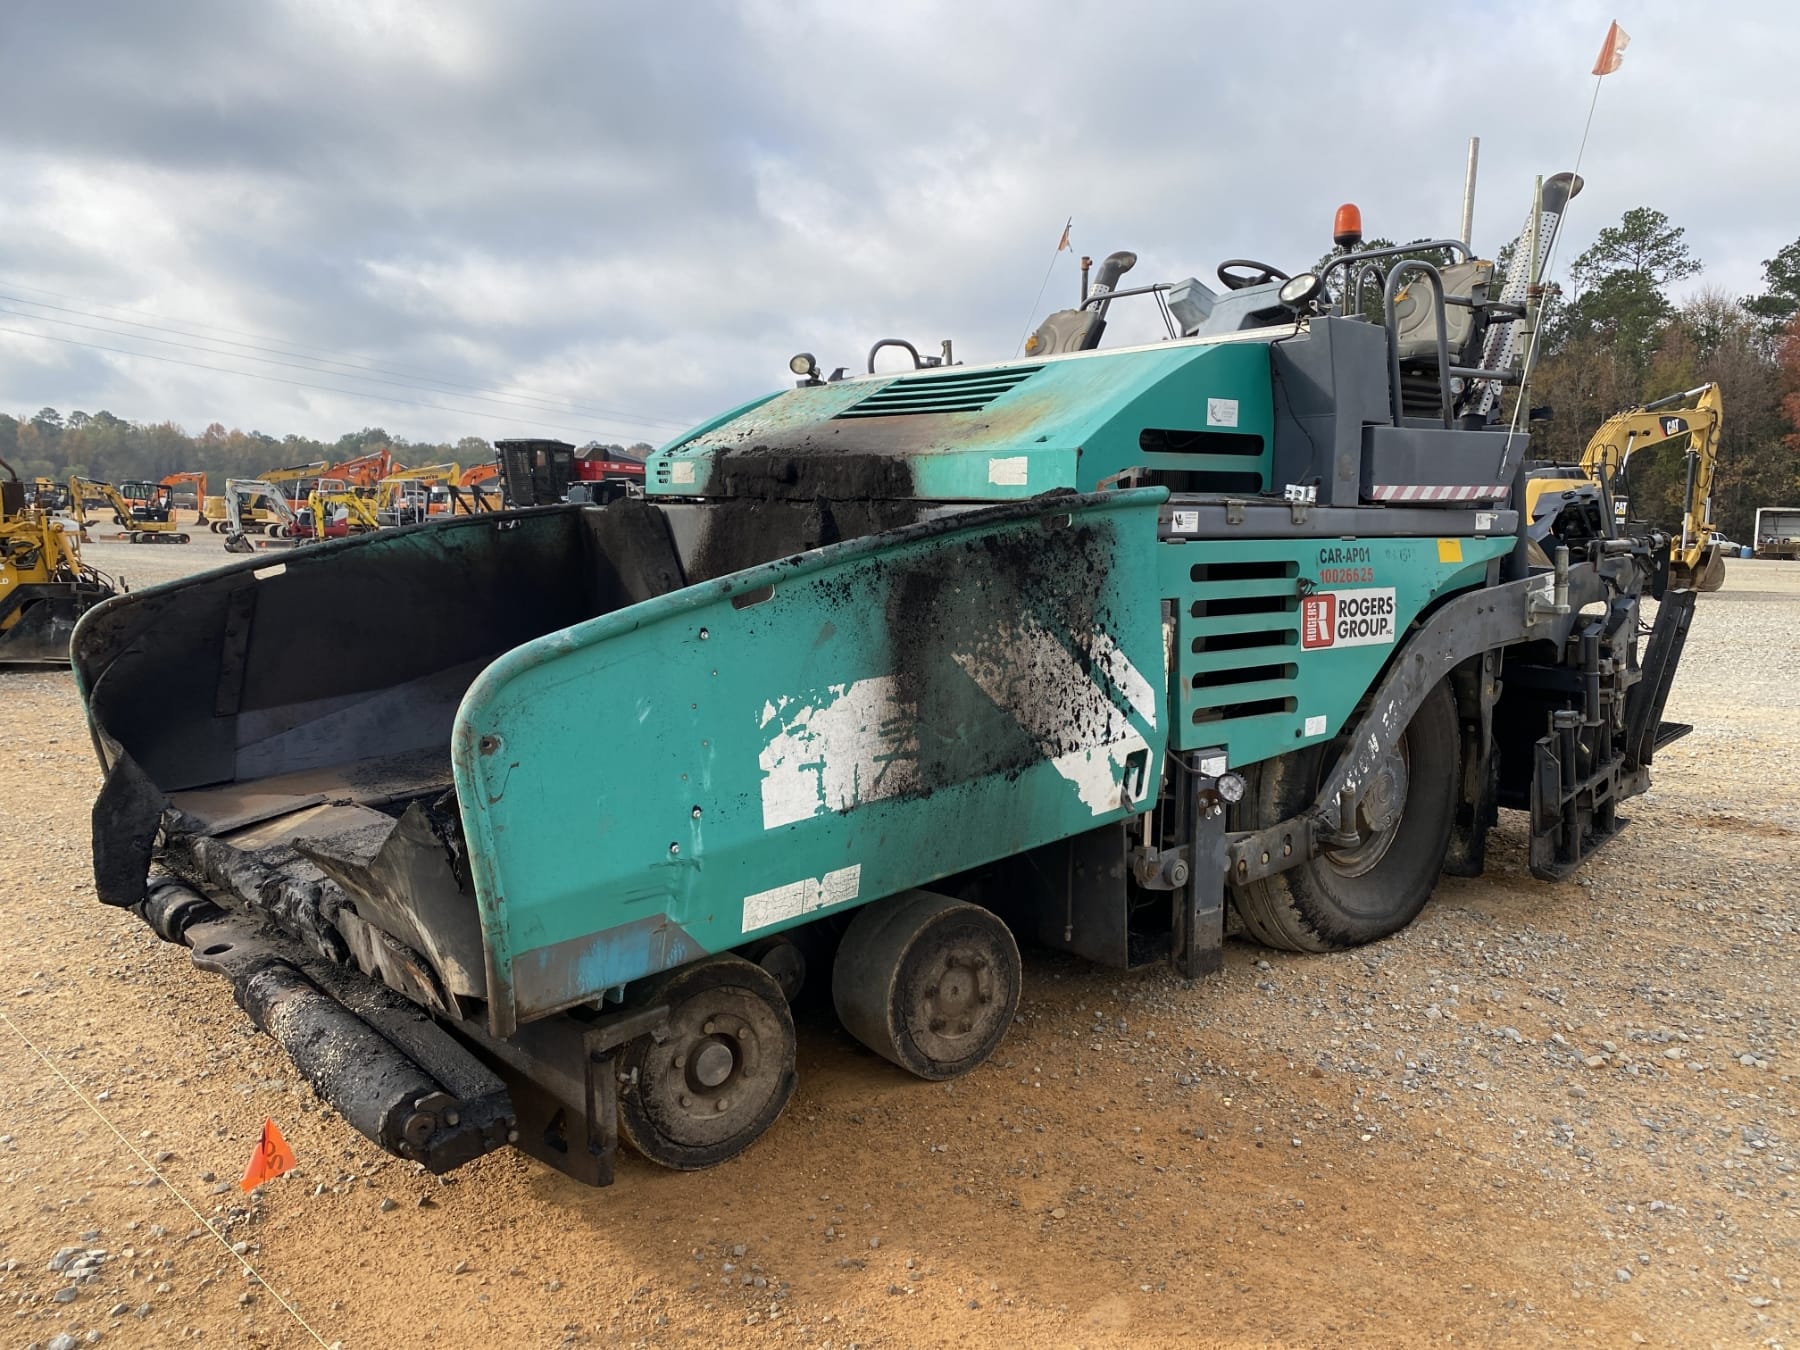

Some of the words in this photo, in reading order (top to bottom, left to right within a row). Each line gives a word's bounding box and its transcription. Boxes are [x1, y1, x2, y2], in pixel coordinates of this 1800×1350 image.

[1666, 418, 1679, 435] CAT
[1614, 502, 1627, 513] CAT
[1320, 547, 1371, 564] CAR-AP01
[1320, 567, 1374, 584] 10026625
[1339, 596, 1394, 618] ROGERS
[1307, 602, 1317, 641] ROGERS
[1337, 617, 1388, 639] GROUP
